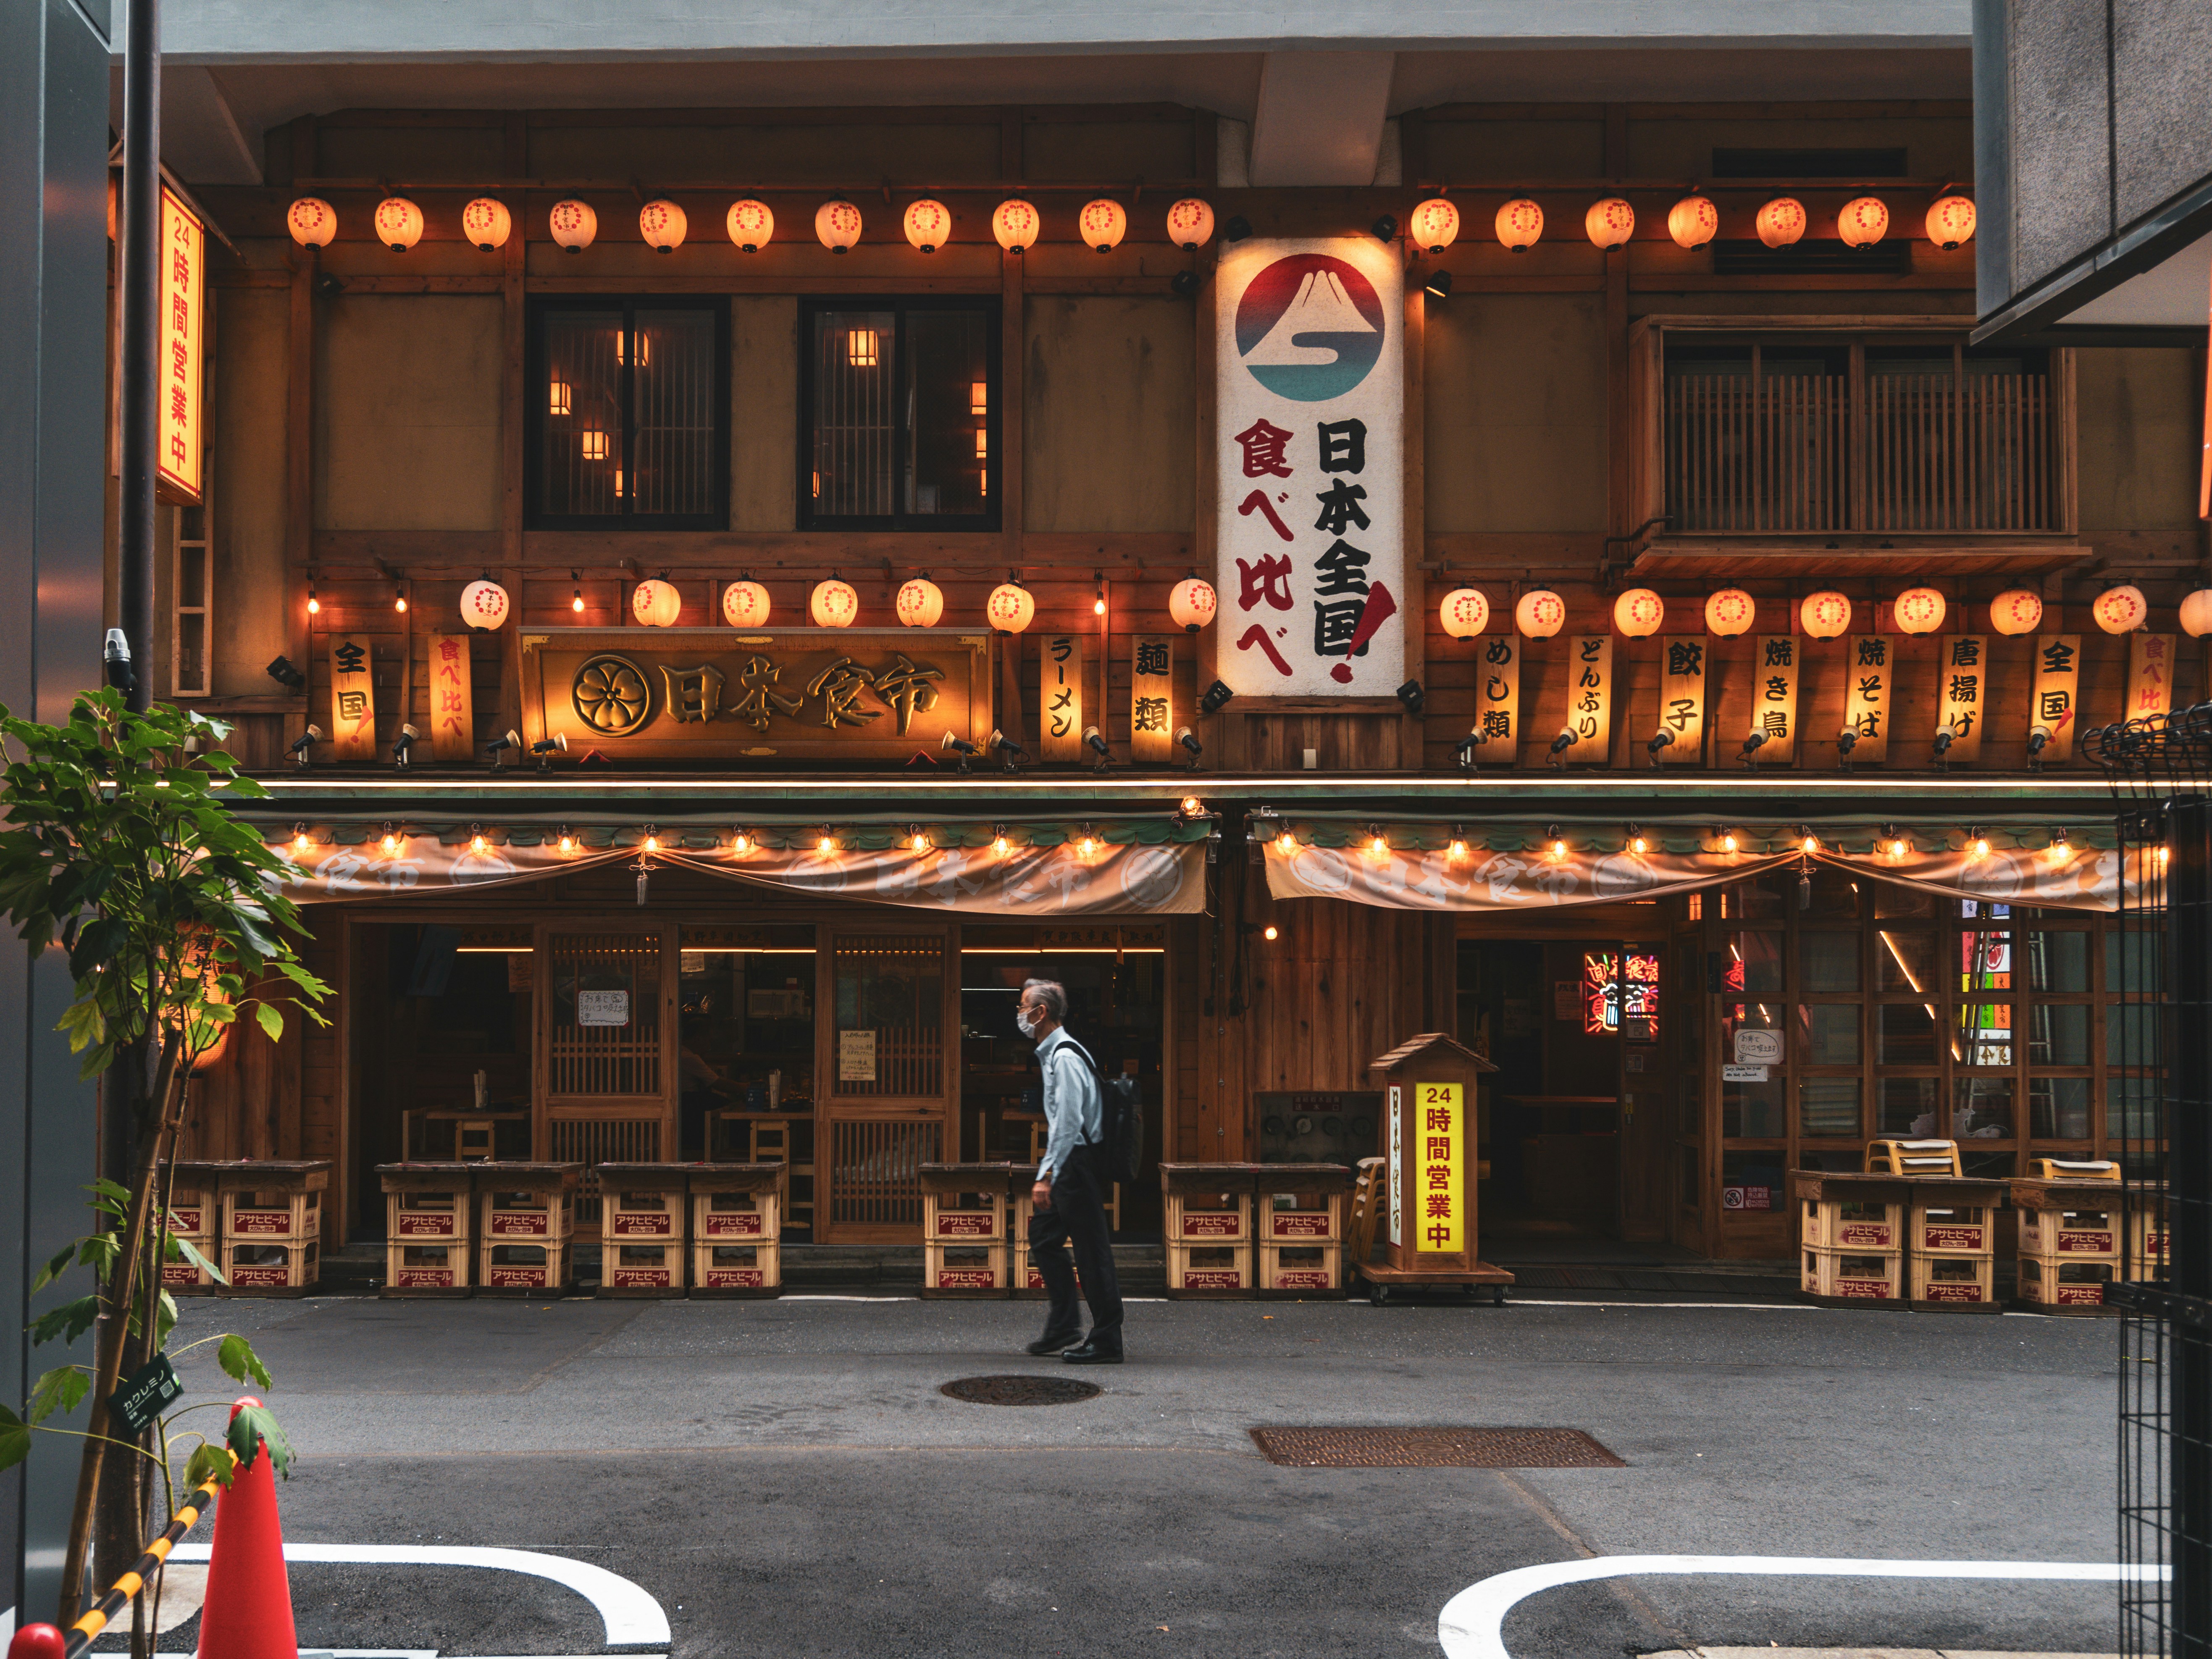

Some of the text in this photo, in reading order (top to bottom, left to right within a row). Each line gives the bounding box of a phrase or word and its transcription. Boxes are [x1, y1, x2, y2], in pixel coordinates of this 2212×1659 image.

[172, 216, 190, 471] 24時間営業中
[1234, 418, 1294, 676] 食べ比べ
[438, 638, 462, 737] 食べ比べ
[1048, 639, 1072, 738] ラーメン
[1134, 642, 1169, 732] 麺類
[1483, 639, 1512, 739] めし類
[1578, 639, 1604, 739] どんぶり
[1666, 641, 1702, 731] 餃子
[1763, 639, 1792, 738] 焼き鳥
[1856, 639, 1886, 738] 焼そば
[1949, 638, 1980, 738] 唐揚げ
[658, 654, 945, 737] 日本食市
[874, 849, 1097, 908] 日本食市
[1356, 848, 1583, 906] 日本食市
[1426, 1088, 1452, 1249] 24時間営業中
[236, 1215, 288, 1224] アサヒビール
[402, 1217, 451, 1225] アサヒビール
[494, 1216, 545, 1225] アサヒビール
[940, 1217, 990, 1225] アサヒビール
[1185, 1217, 1237, 1225] アサヒビール
[1276, 1217, 1327, 1226] アサヒビール
[1928, 1230, 1980, 1239] アサヒビール
[2060, 1234, 2110, 1243] アサヒビール
[234, 1271, 286, 1279] アサヒビール
[400, 1272, 451, 1280] アサヒビール
[493, 1271, 544, 1280] アサヒビール
[617, 1272, 667, 1280] アサヒビール
[709, 1273, 760, 1281] アサヒビール
[941, 1273, 992, 1281] アサヒビール
[1187, 1274, 1237, 1283] アサヒビール
[1929, 1286, 1979, 1295] アサヒビール
[2060, 1289, 2102, 1298] アサヒビー
[123, 1370, 164, 1412] カクレミノ
